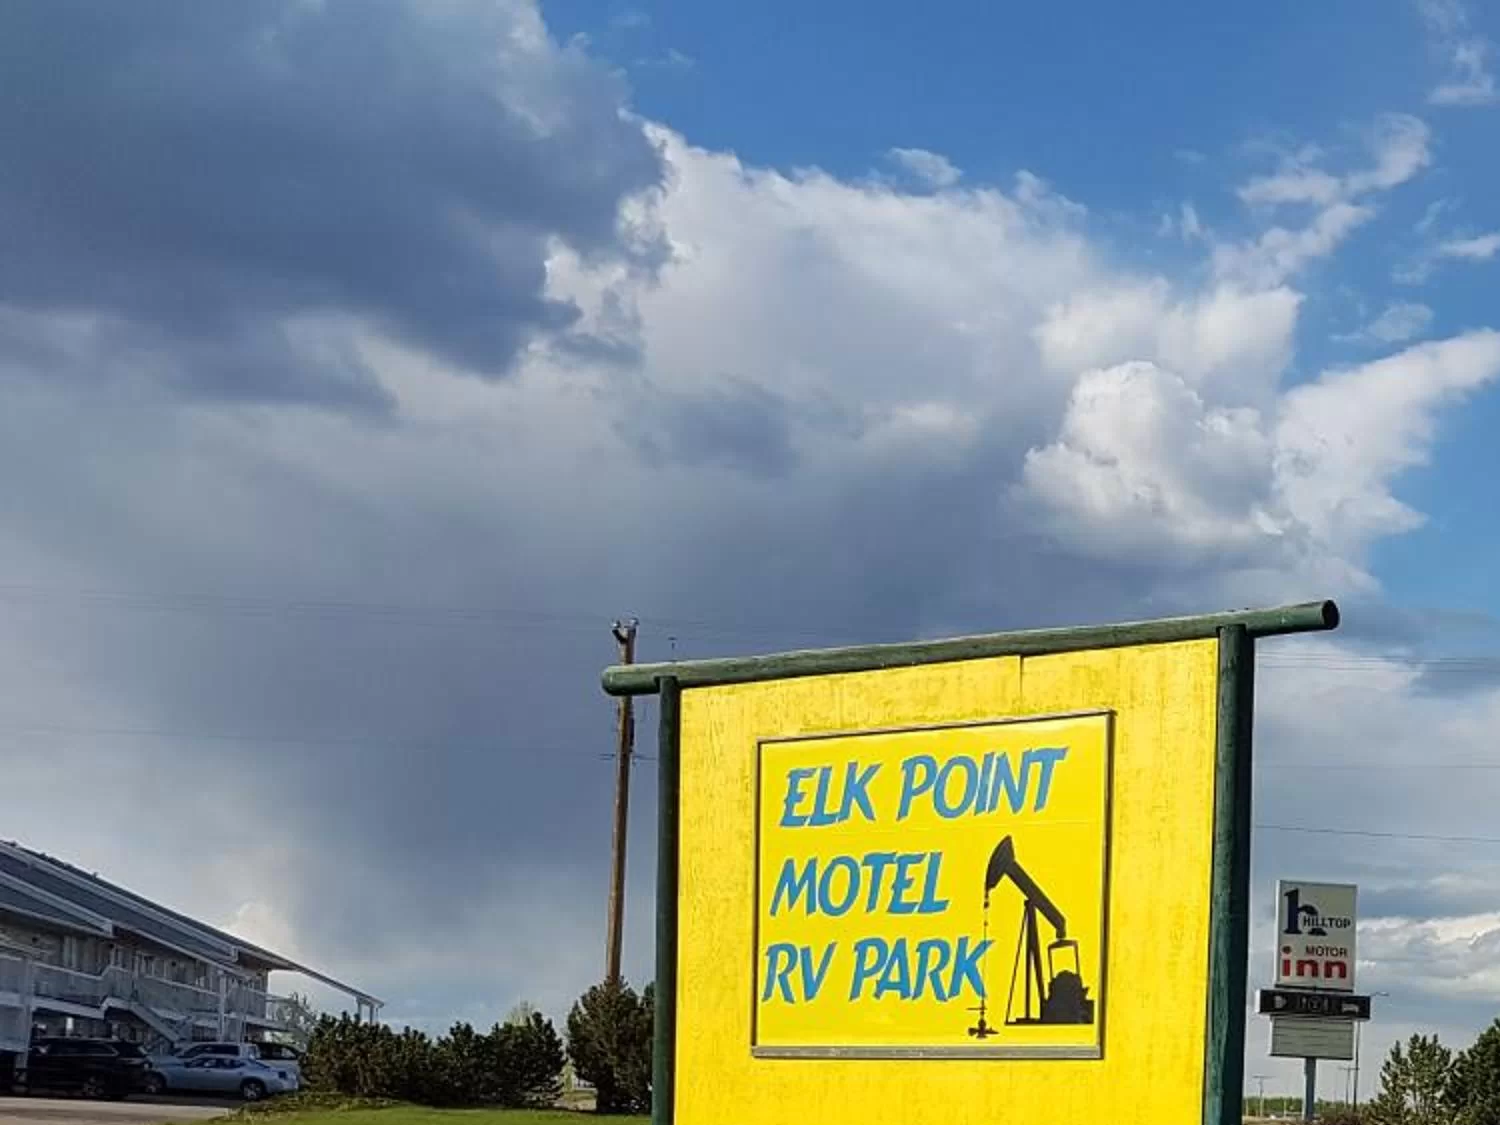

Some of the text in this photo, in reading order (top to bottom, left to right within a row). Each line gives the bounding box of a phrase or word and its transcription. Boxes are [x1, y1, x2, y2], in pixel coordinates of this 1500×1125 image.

[779, 747, 1069, 828] ELK POINT
[769, 852, 949, 917] MOTEL
[1303, 916, 1350, 930] HILLTOP
[762, 936, 994, 1003] RV PARK
[1282, 946, 1347, 979] inn
[1305, 945, 1348, 957] MOTOR
